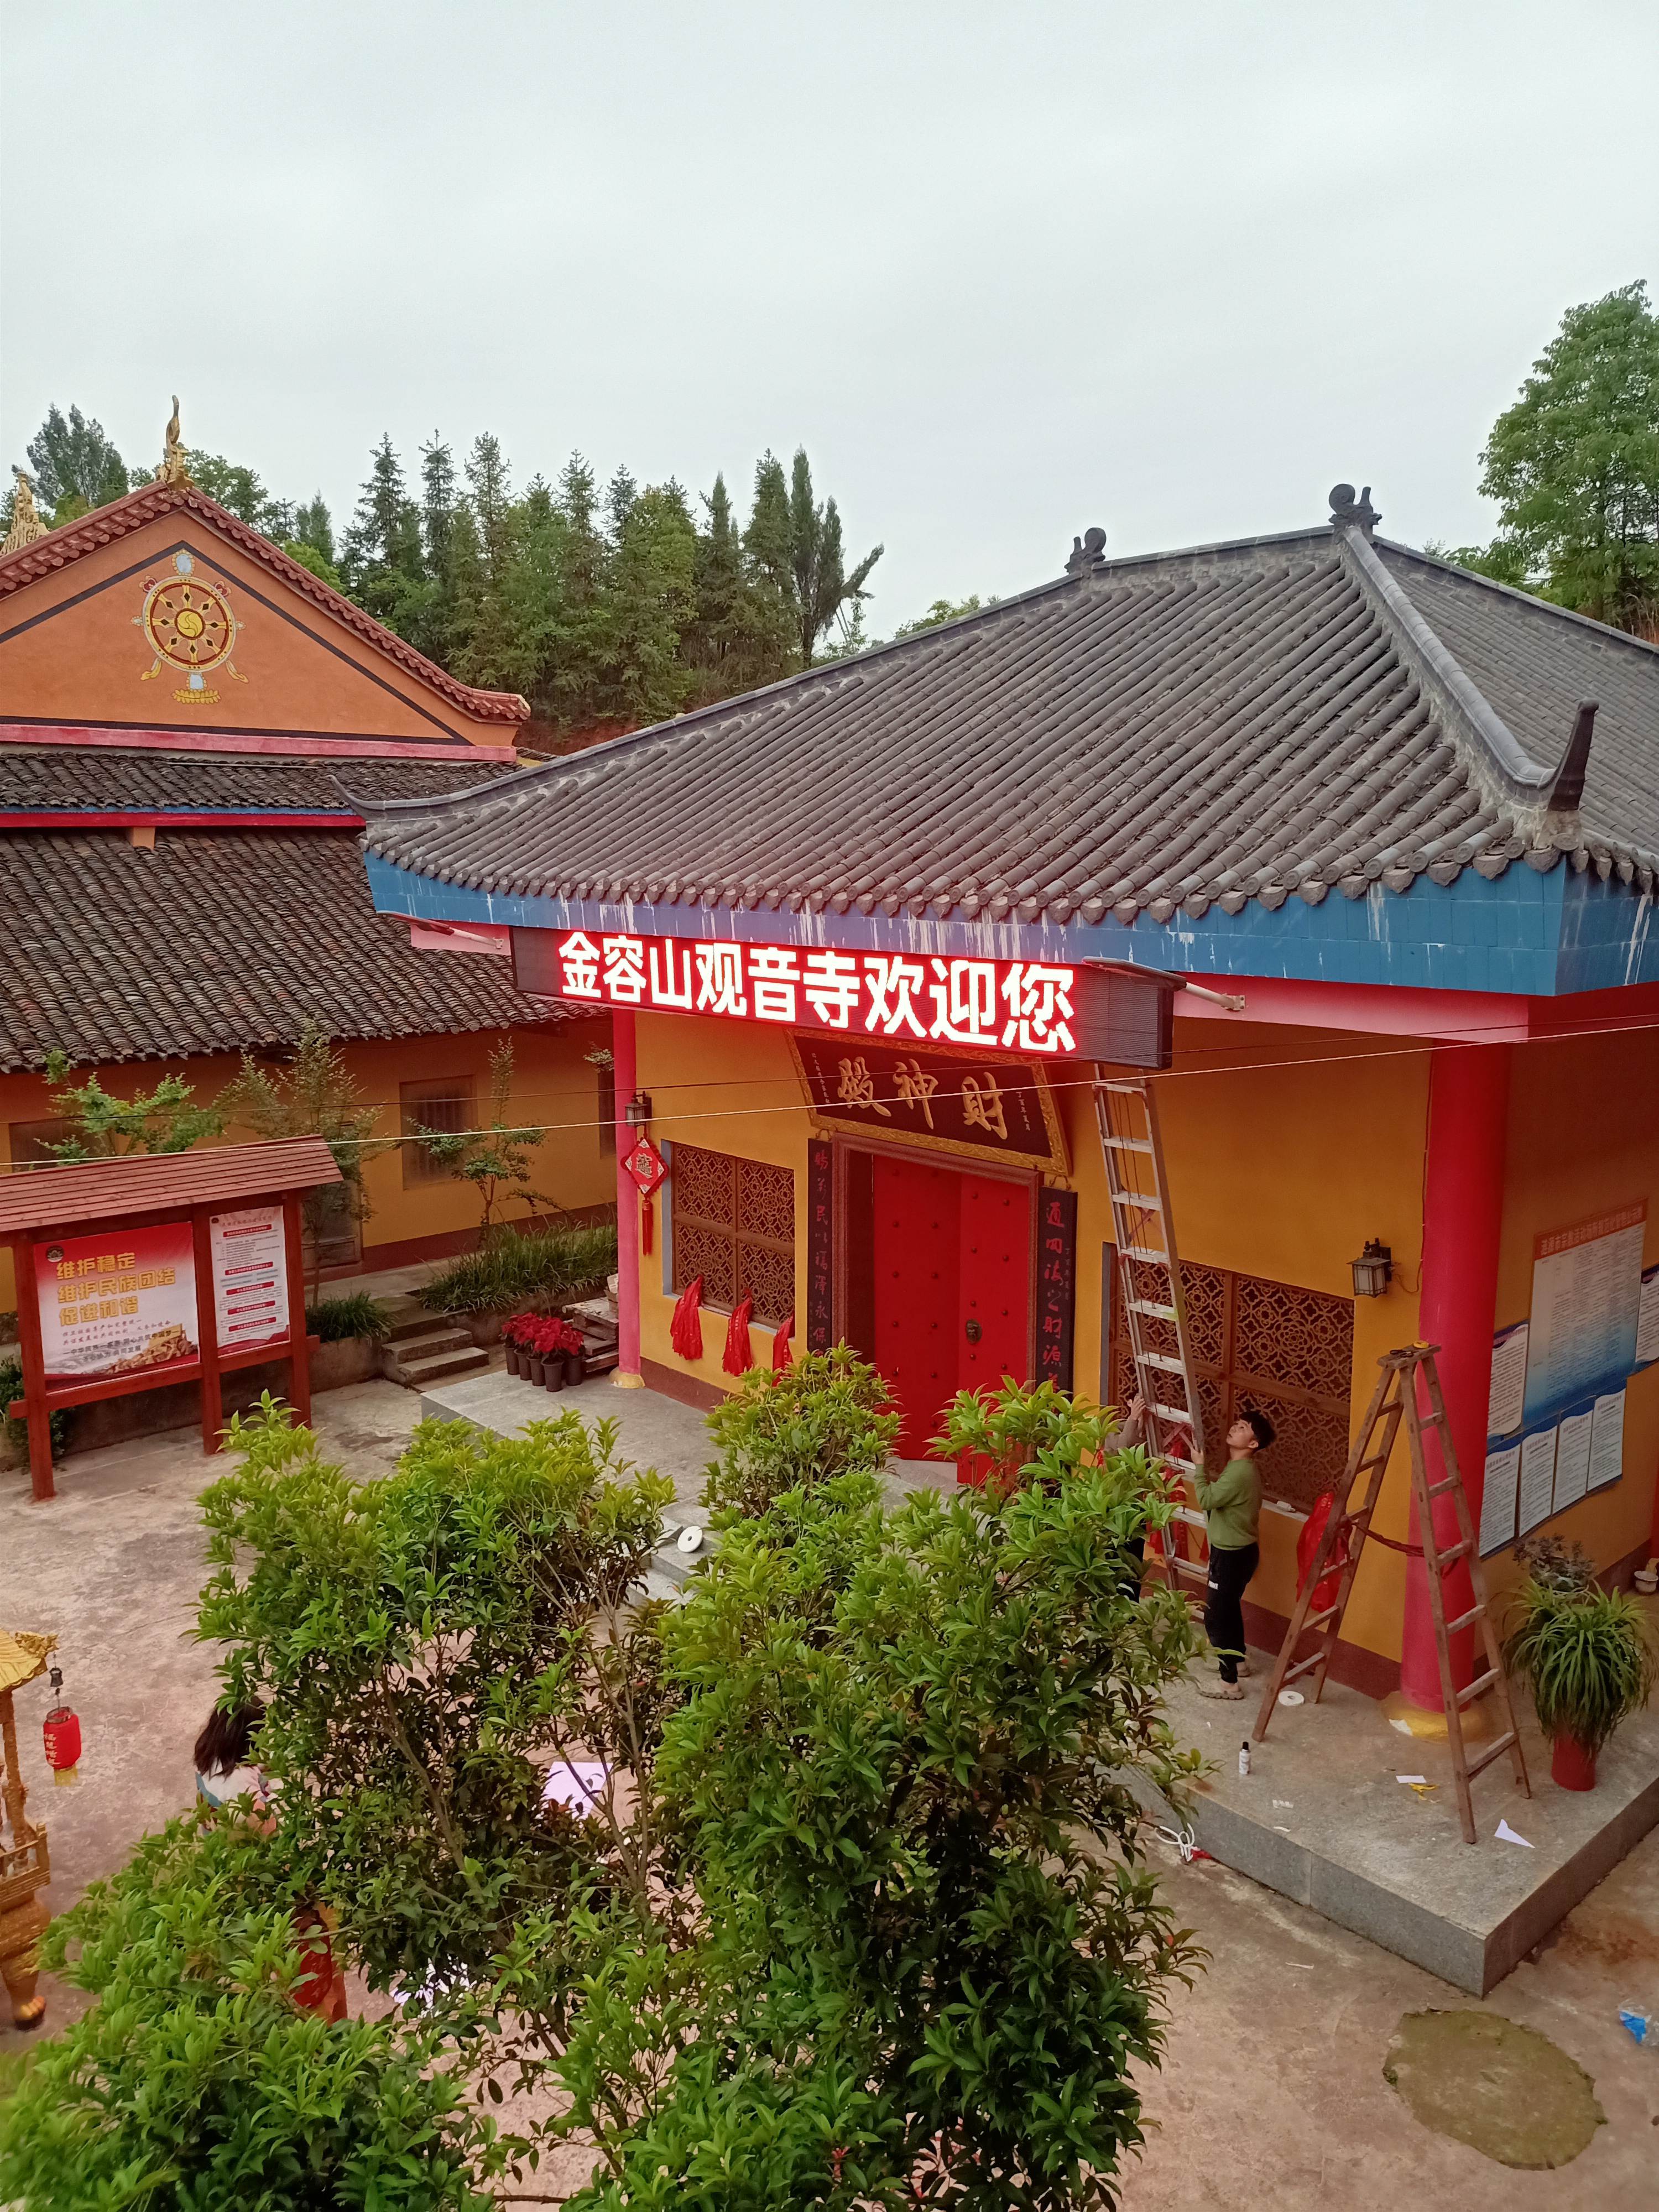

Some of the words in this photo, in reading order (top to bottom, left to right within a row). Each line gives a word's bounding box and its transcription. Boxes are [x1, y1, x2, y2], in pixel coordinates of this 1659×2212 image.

[558, 931, 1077, 1052] 金容山观音寺欢迎您
[56, 1252, 135, 1280] 维护稳定
[58, 1267, 176, 1303] 维护民族团结
[59, 1296, 138, 1327] 促进和谐
